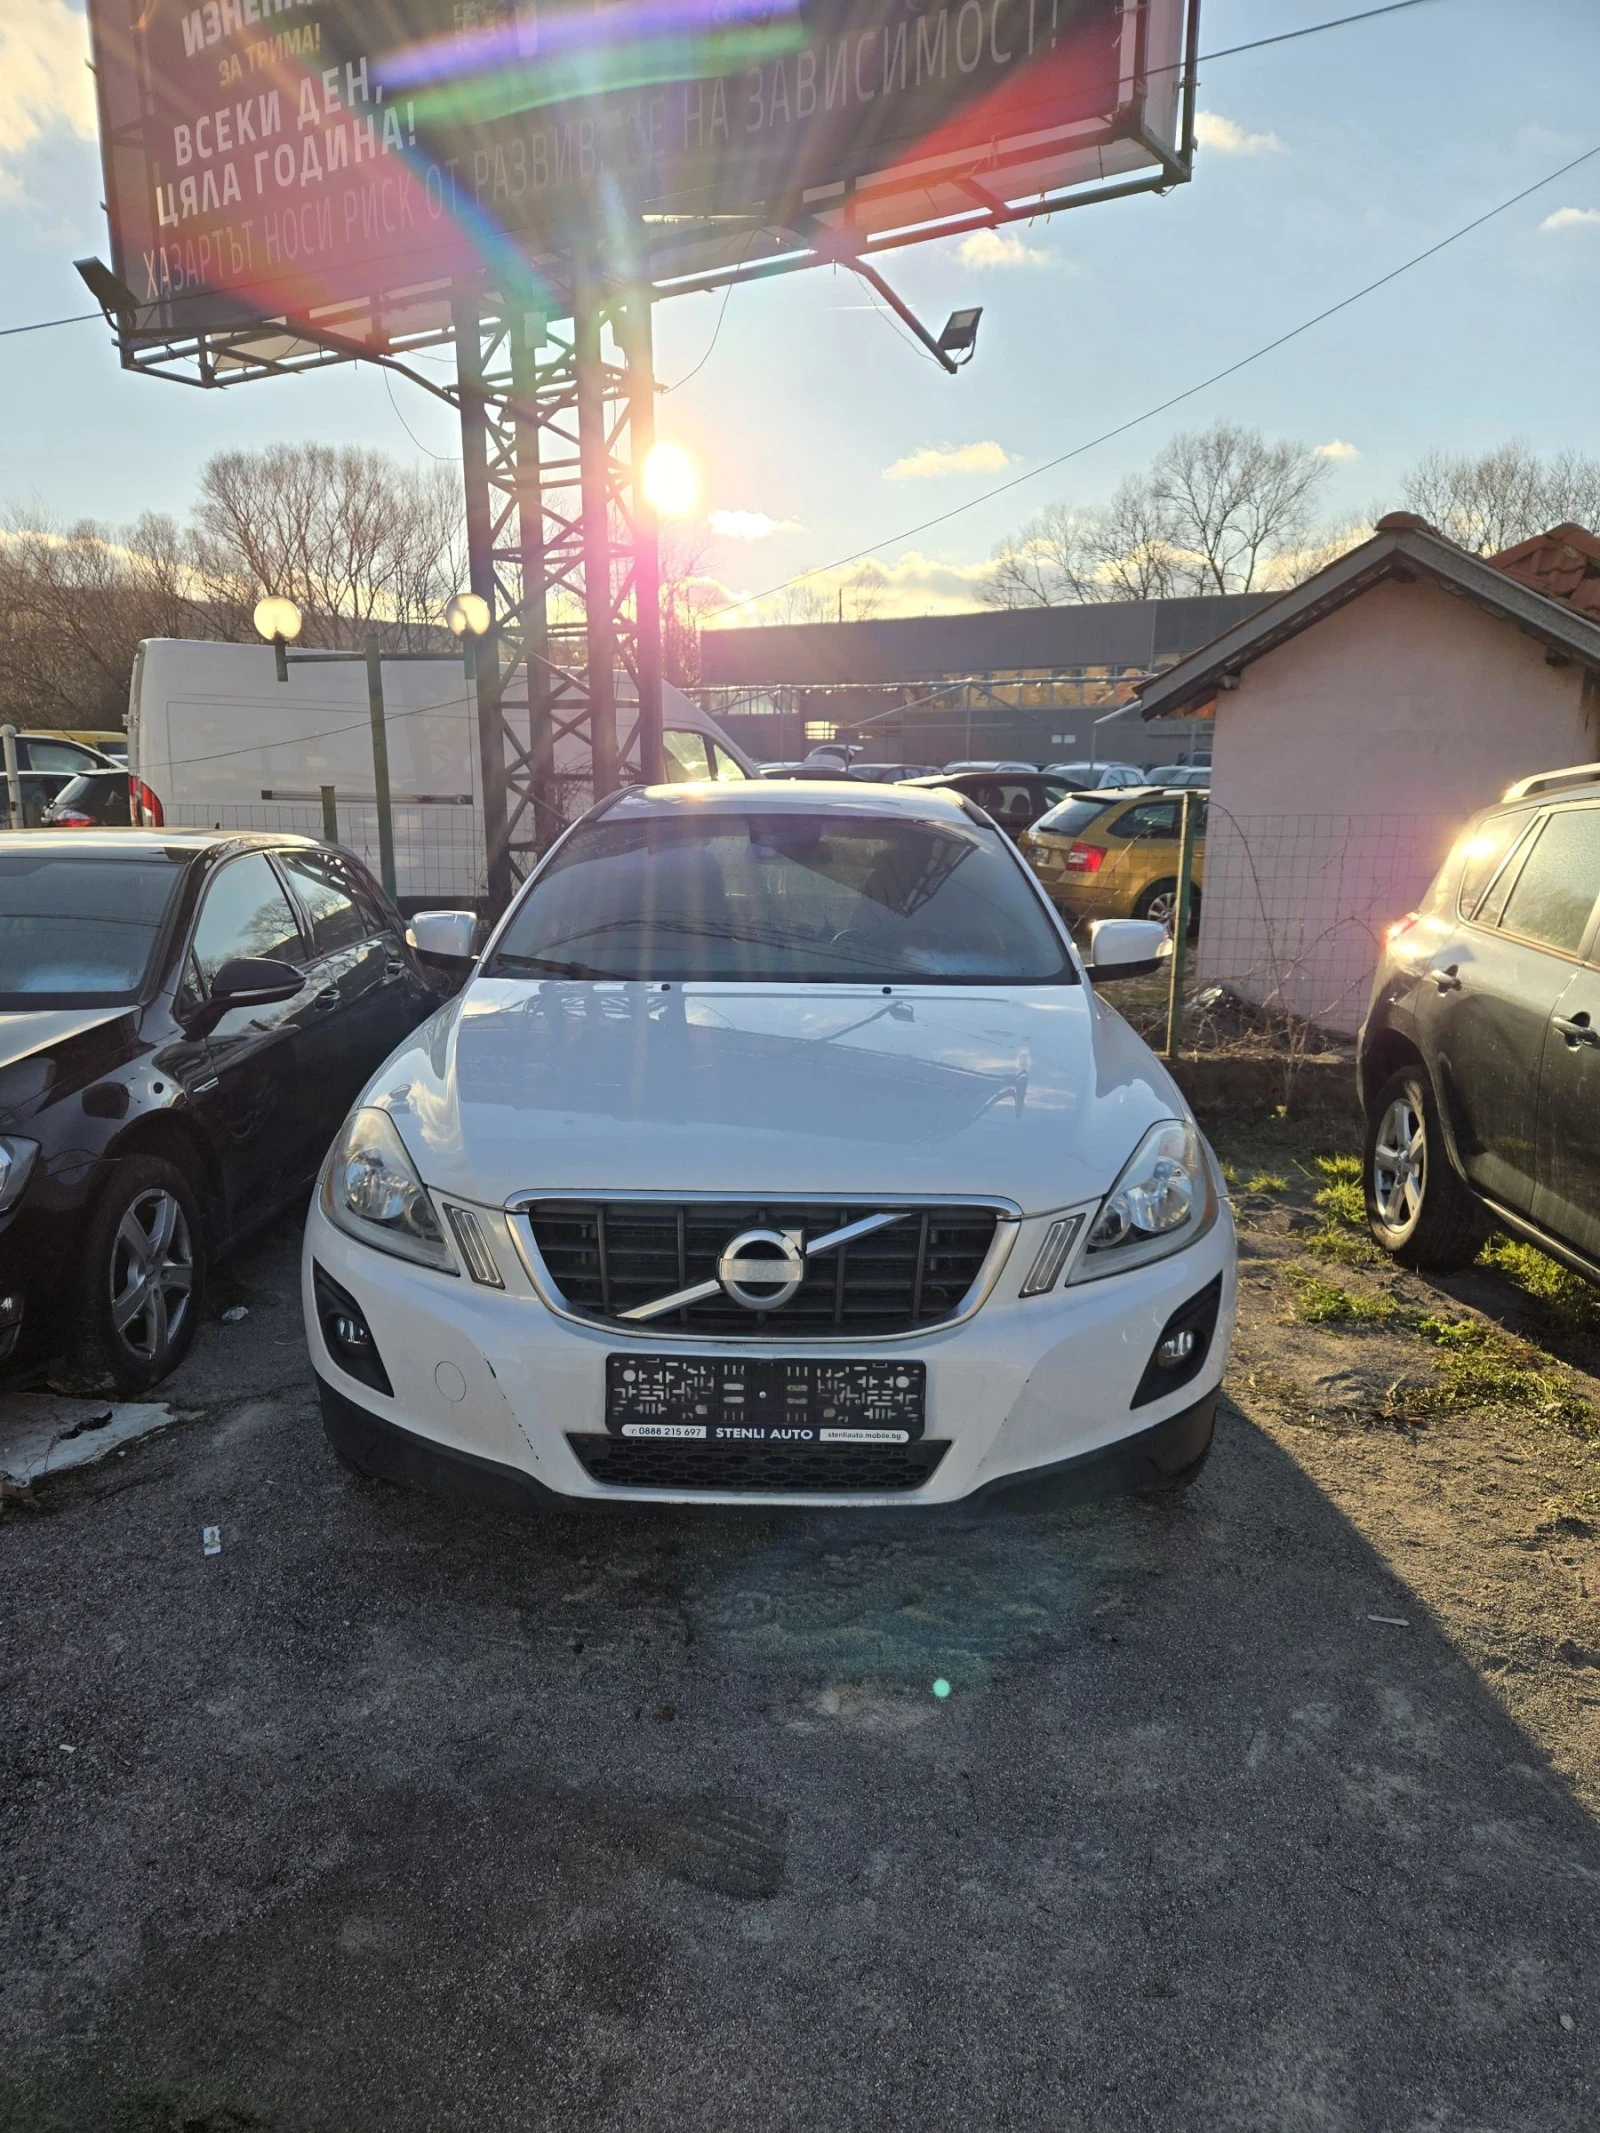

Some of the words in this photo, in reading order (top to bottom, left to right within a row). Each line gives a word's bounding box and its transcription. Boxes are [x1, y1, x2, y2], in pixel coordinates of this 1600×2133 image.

[218, 54, 243, 88] ЗА
[244, 22, 320, 73] ТРИМА!
[173, 90, 282, 168] ВСЕКИ
[296, 56, 384, 131] ДЕН,
[143, 220, 254, 300] ХАЗАРТЪТ
[265, 194, 335, 266] НОСИ
[345, 171, 415, 252] РИСК
[425, 157, 461, 221] ОТ
[683, 77, 730, 150] НА
[154, 162, 243, 228] ЦЯЛА
[254, 101, 417, 195] ГОДИНА!
[638, 1426, 662, 1436] 0888
[664, 1427, 682, 1436] 215
[684, 1428, 701, 1437] 697
[715, 1427, 765, 1439] STENLI
[769, 1428, 813, 1440] AUTO
[827, 1431, 902, 1441] stenliauto.mobile.bg
